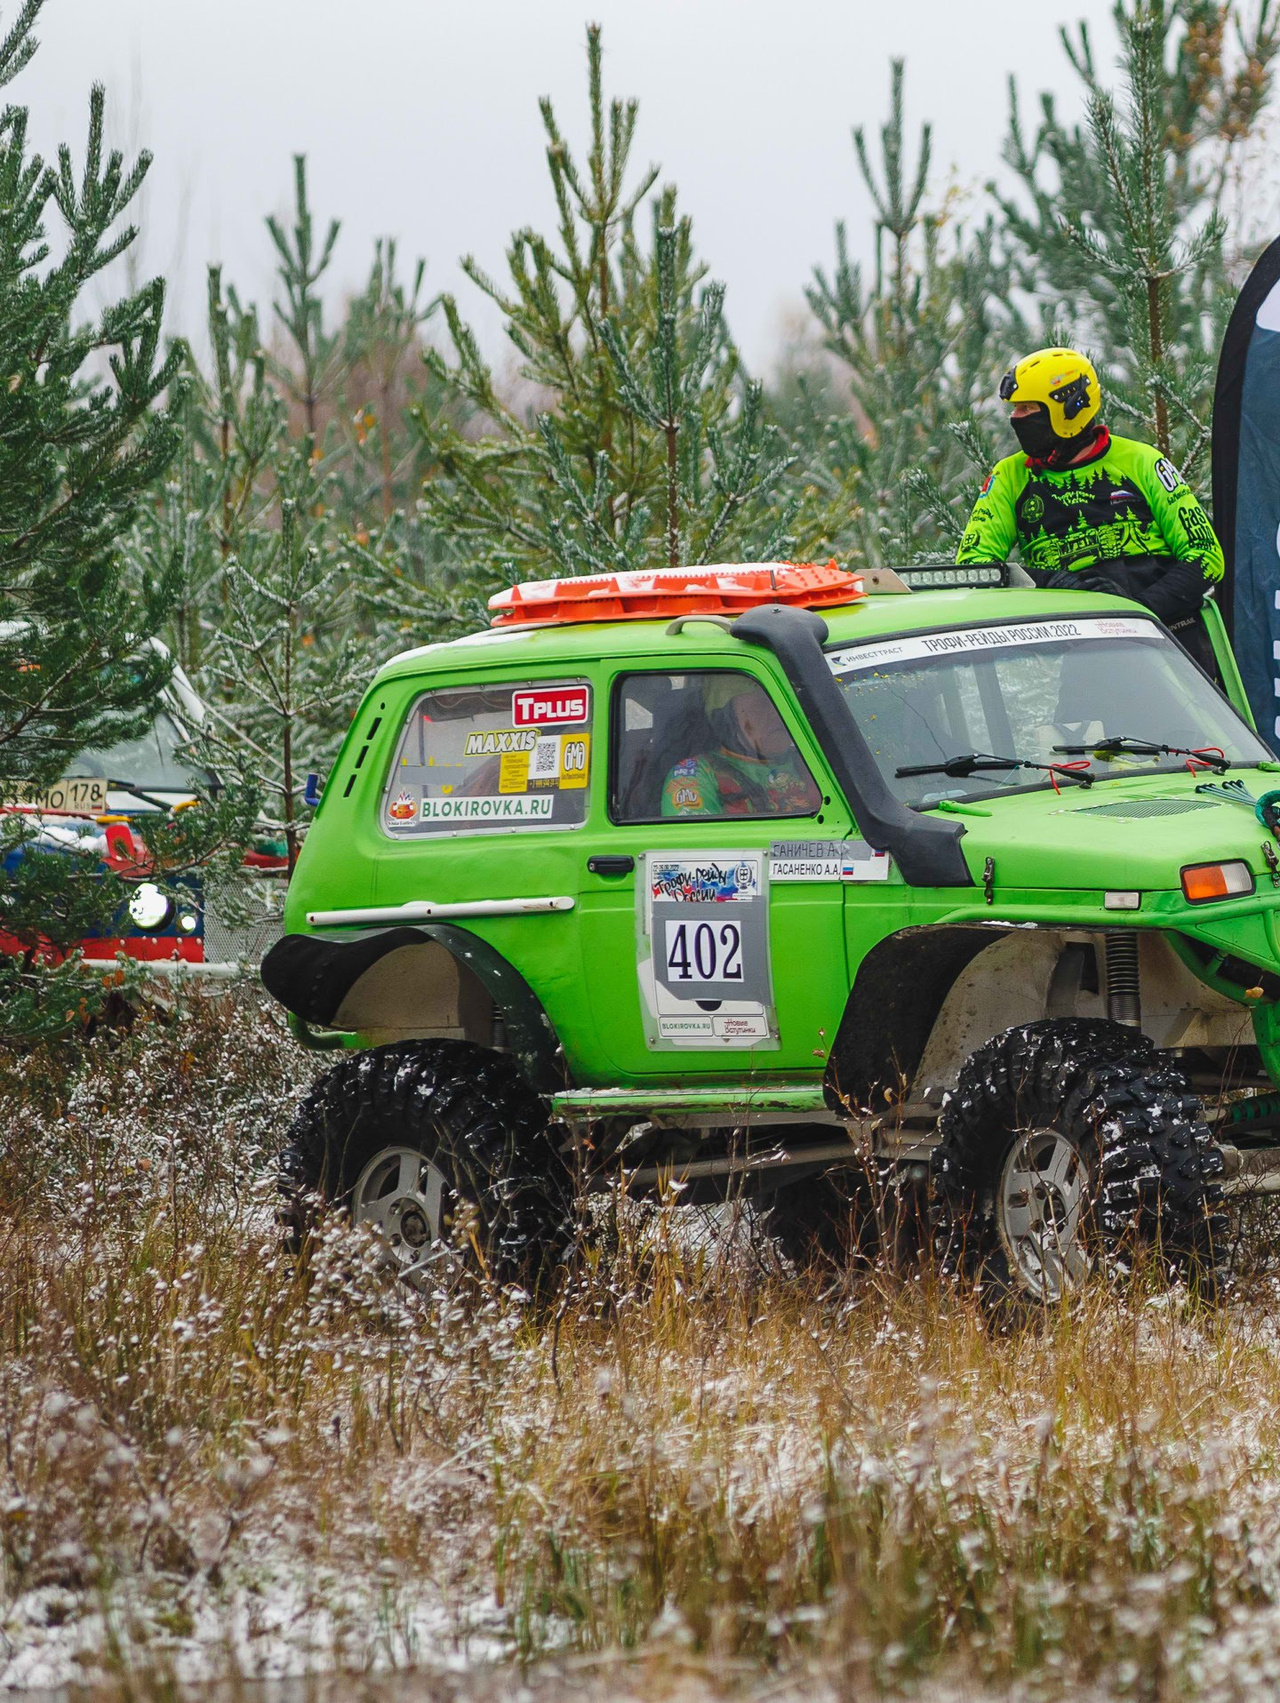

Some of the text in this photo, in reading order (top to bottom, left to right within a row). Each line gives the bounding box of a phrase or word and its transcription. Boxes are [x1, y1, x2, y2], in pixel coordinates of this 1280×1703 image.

[921, 629, 1011, 653] ТРОФИ-РЕЙДЫ
[846, 646, 903, 663] ИНВЕСТТРАСТ
[466, 730, 537, 755] MAXXIS
[70, 783, 101, 802] 178
[422, 799, 551, 818] BLOKIROVKA.RU
[772, 863, 823, 876] ГАСАНЕНКО
[668, 923, 742, 980] 402
